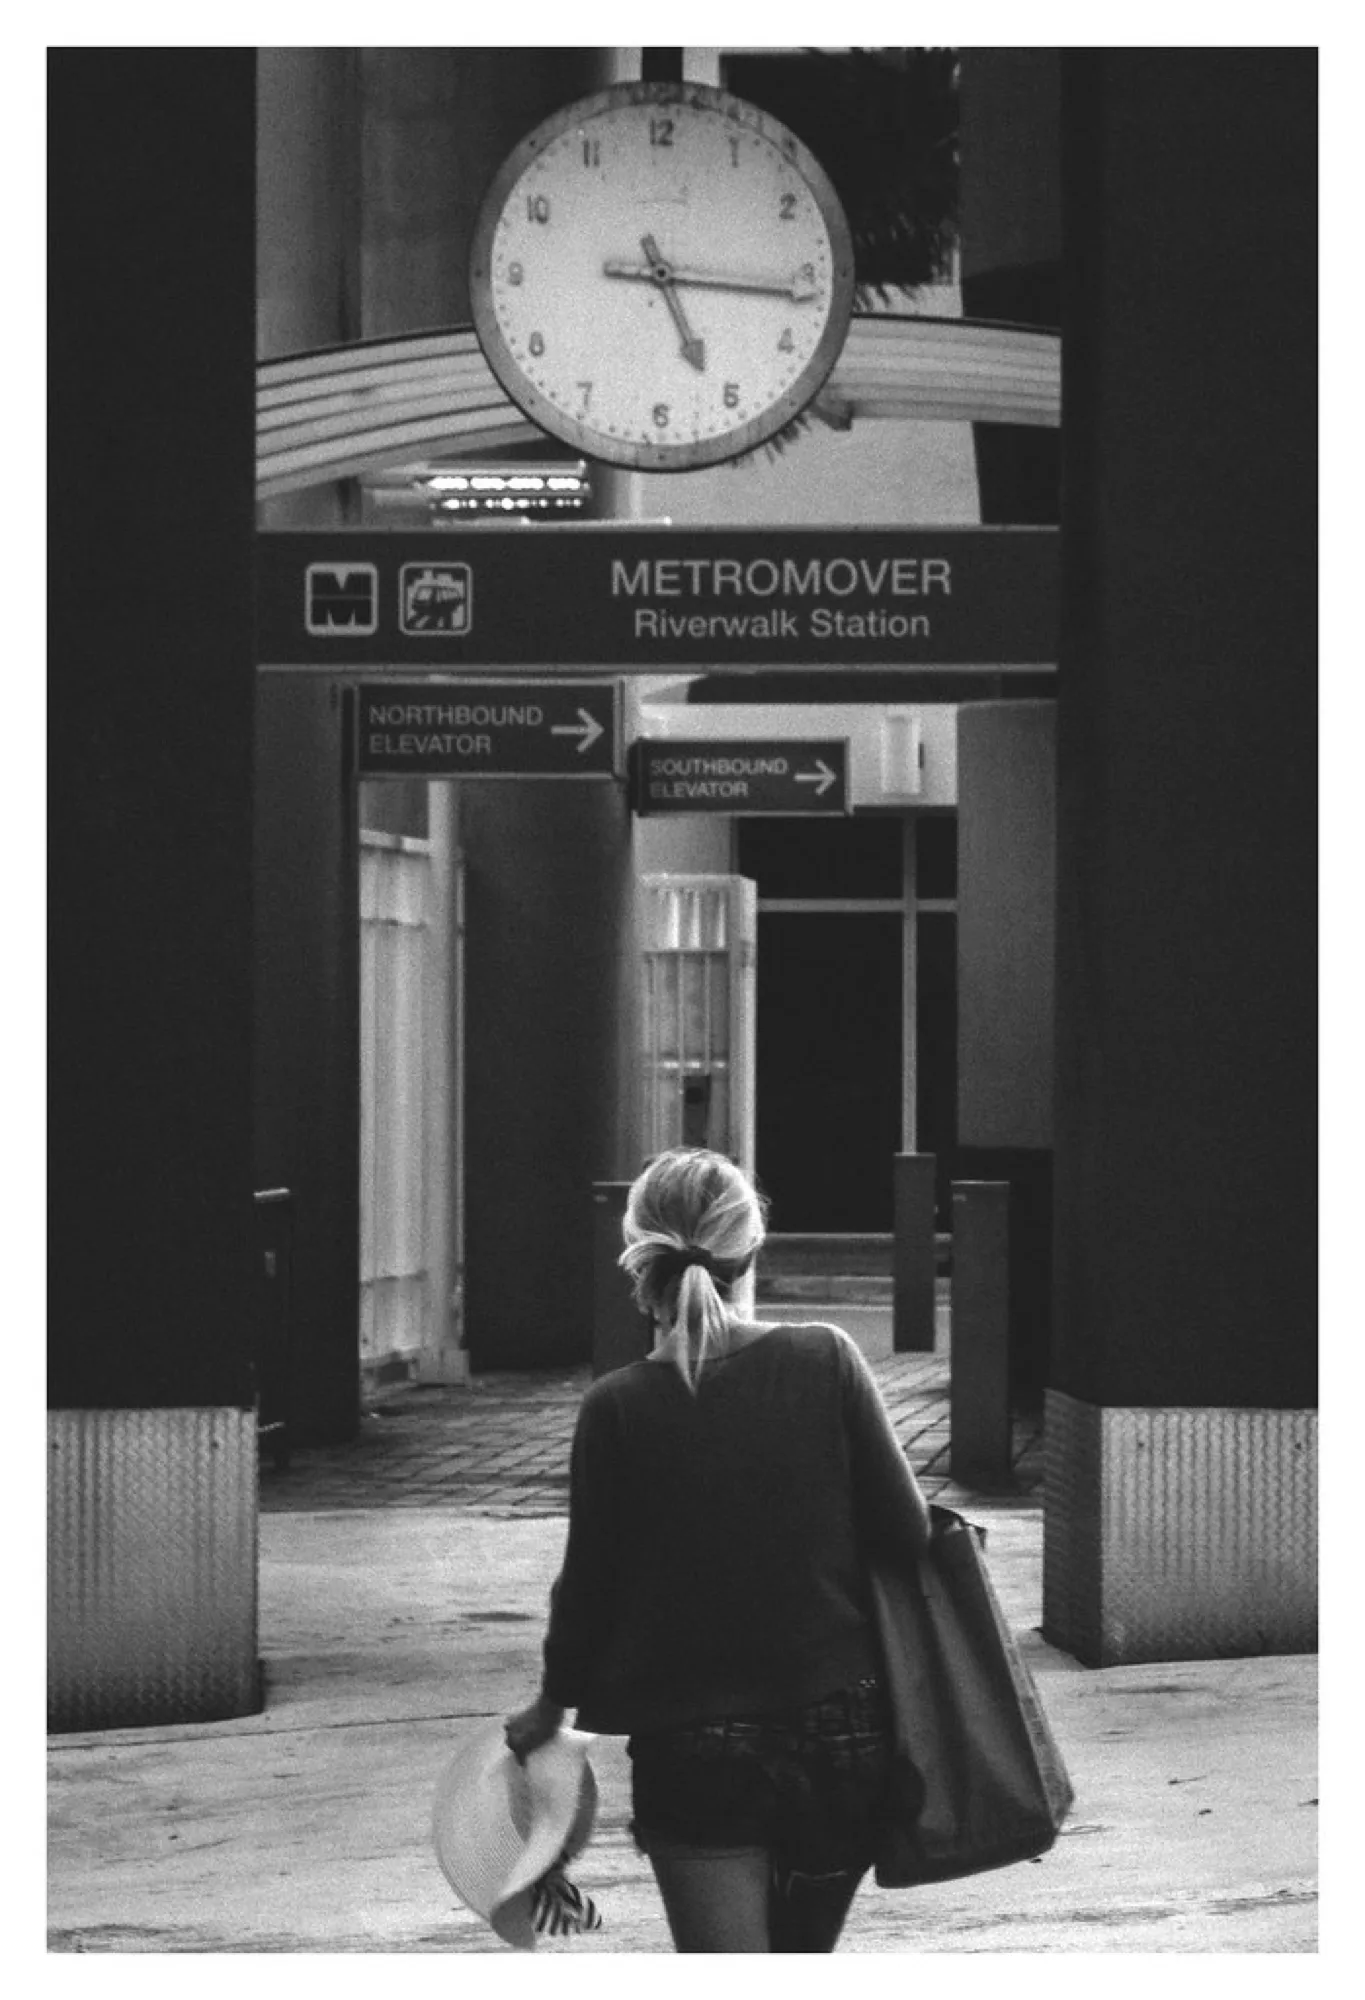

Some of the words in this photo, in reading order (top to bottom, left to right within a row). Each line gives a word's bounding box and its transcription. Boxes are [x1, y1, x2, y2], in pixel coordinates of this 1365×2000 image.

[649, 119, 675, 147] 12
[581, 137, 600, 168] 11
[727, 135, 740, 168] 1
[526, 195, 550, 225] 10
[778, 193, 797, 220] 2
[508, 261, 524, 287] 9
[527, 331, 546, 358] 8
[776, 326, 796, 354] 4
[576, 380, 594, 407] 7
[722, 382, 740, 408] 5
[652, 403, 669, 429] 6
[611, 558, 952, 596] METROMOVER
[634, 608, 799, 639] Riverwalk
[809, 608, 931, 639] Station
[369, 704, 544, 727] NORTHBOUND
[369, 733, 492, 755] ELEVATOR
[650, 757, 789, 776] SOUTHBOUND
[650, 780, 749, 799] ELEVATOR
